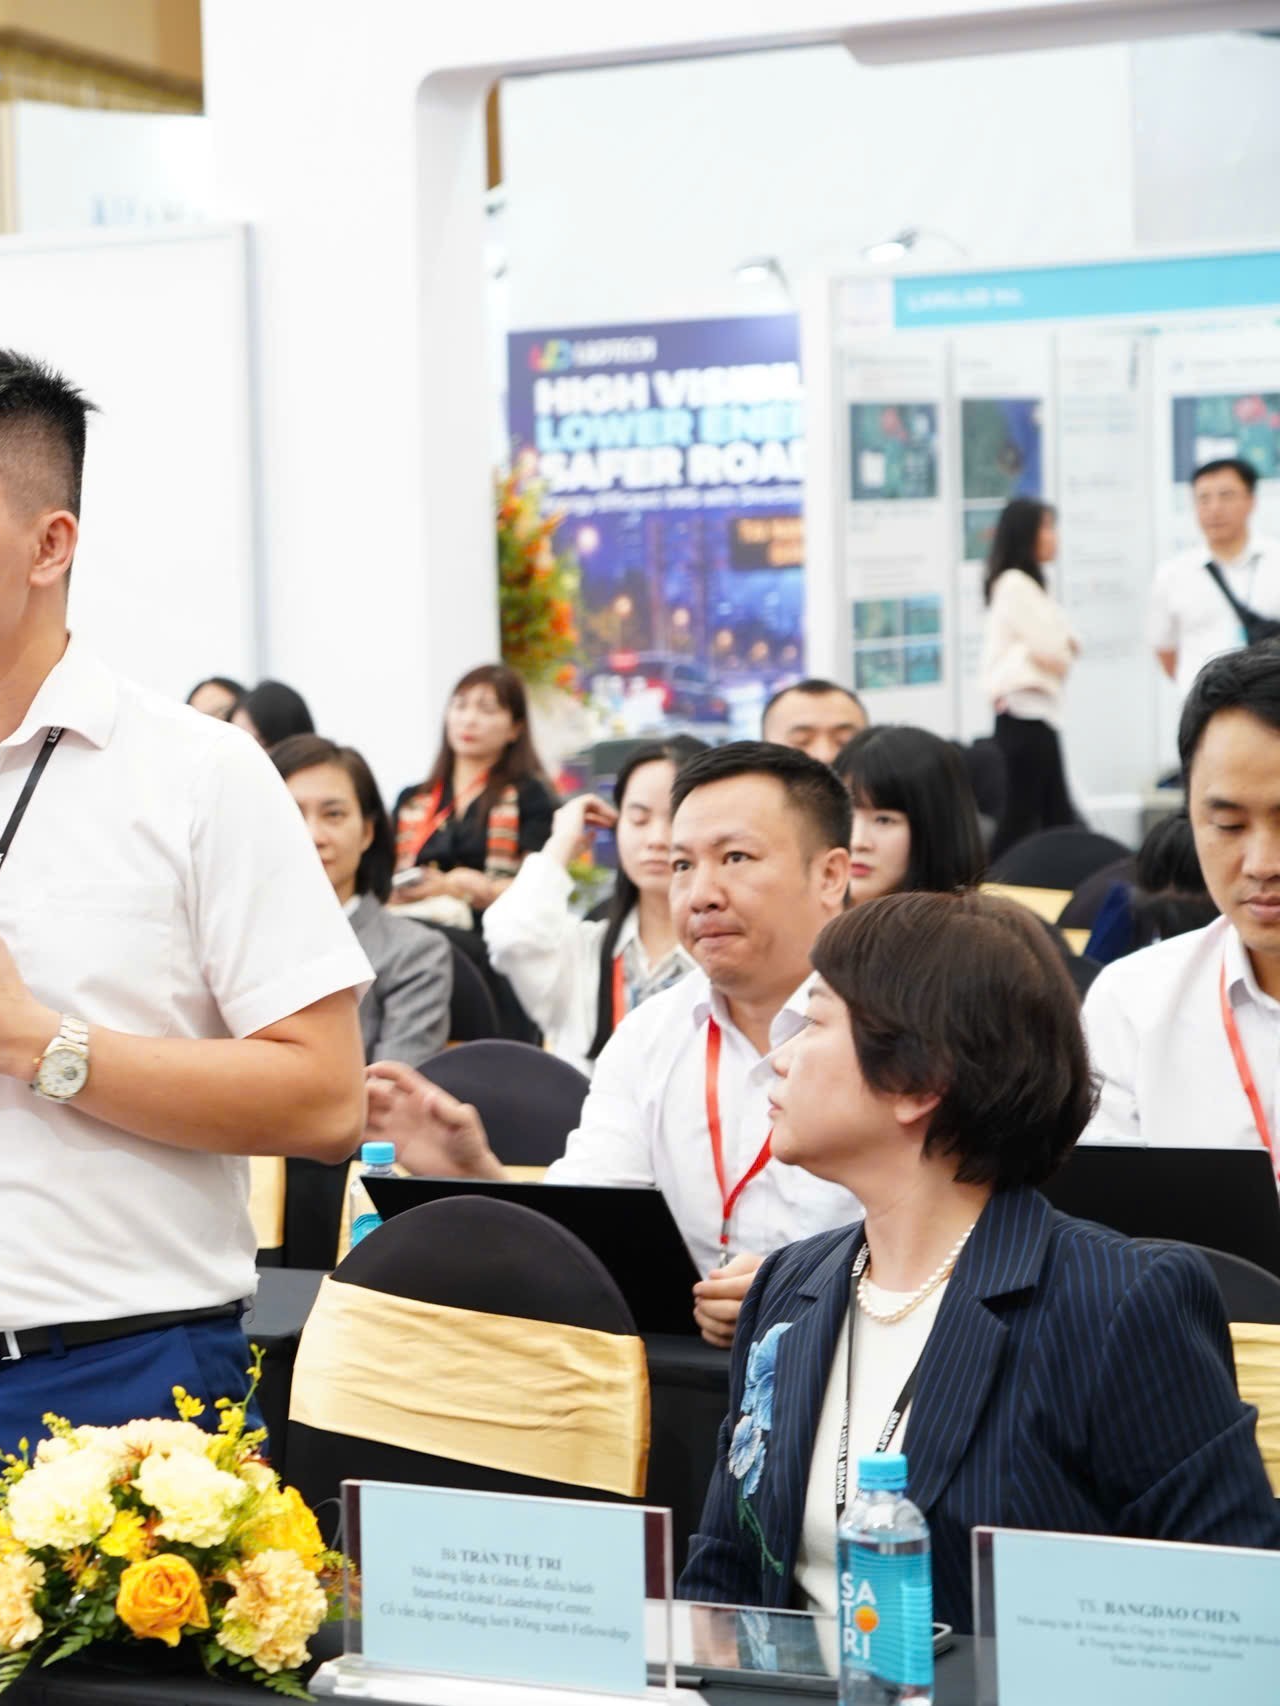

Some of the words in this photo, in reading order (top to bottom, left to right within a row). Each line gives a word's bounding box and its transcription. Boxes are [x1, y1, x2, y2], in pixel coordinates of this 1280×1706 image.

[533, 371, 650, 415] HIGH
[536, 408, 695, 453] LOWER
[538, 446, 684, 494] SAFER
[838, 1428, 848, 1459] TECH
[876, 1410, 901, 1452] SMART
[835, 1460, 847, 1505] POWER
[841, 1572, 877, 1605] SA
[1105, 1601, 1190, 1620] BANGDAO
[1192, 1607, 1241, 1624] CHEN
[843, 1627, 871, 1660] RI
